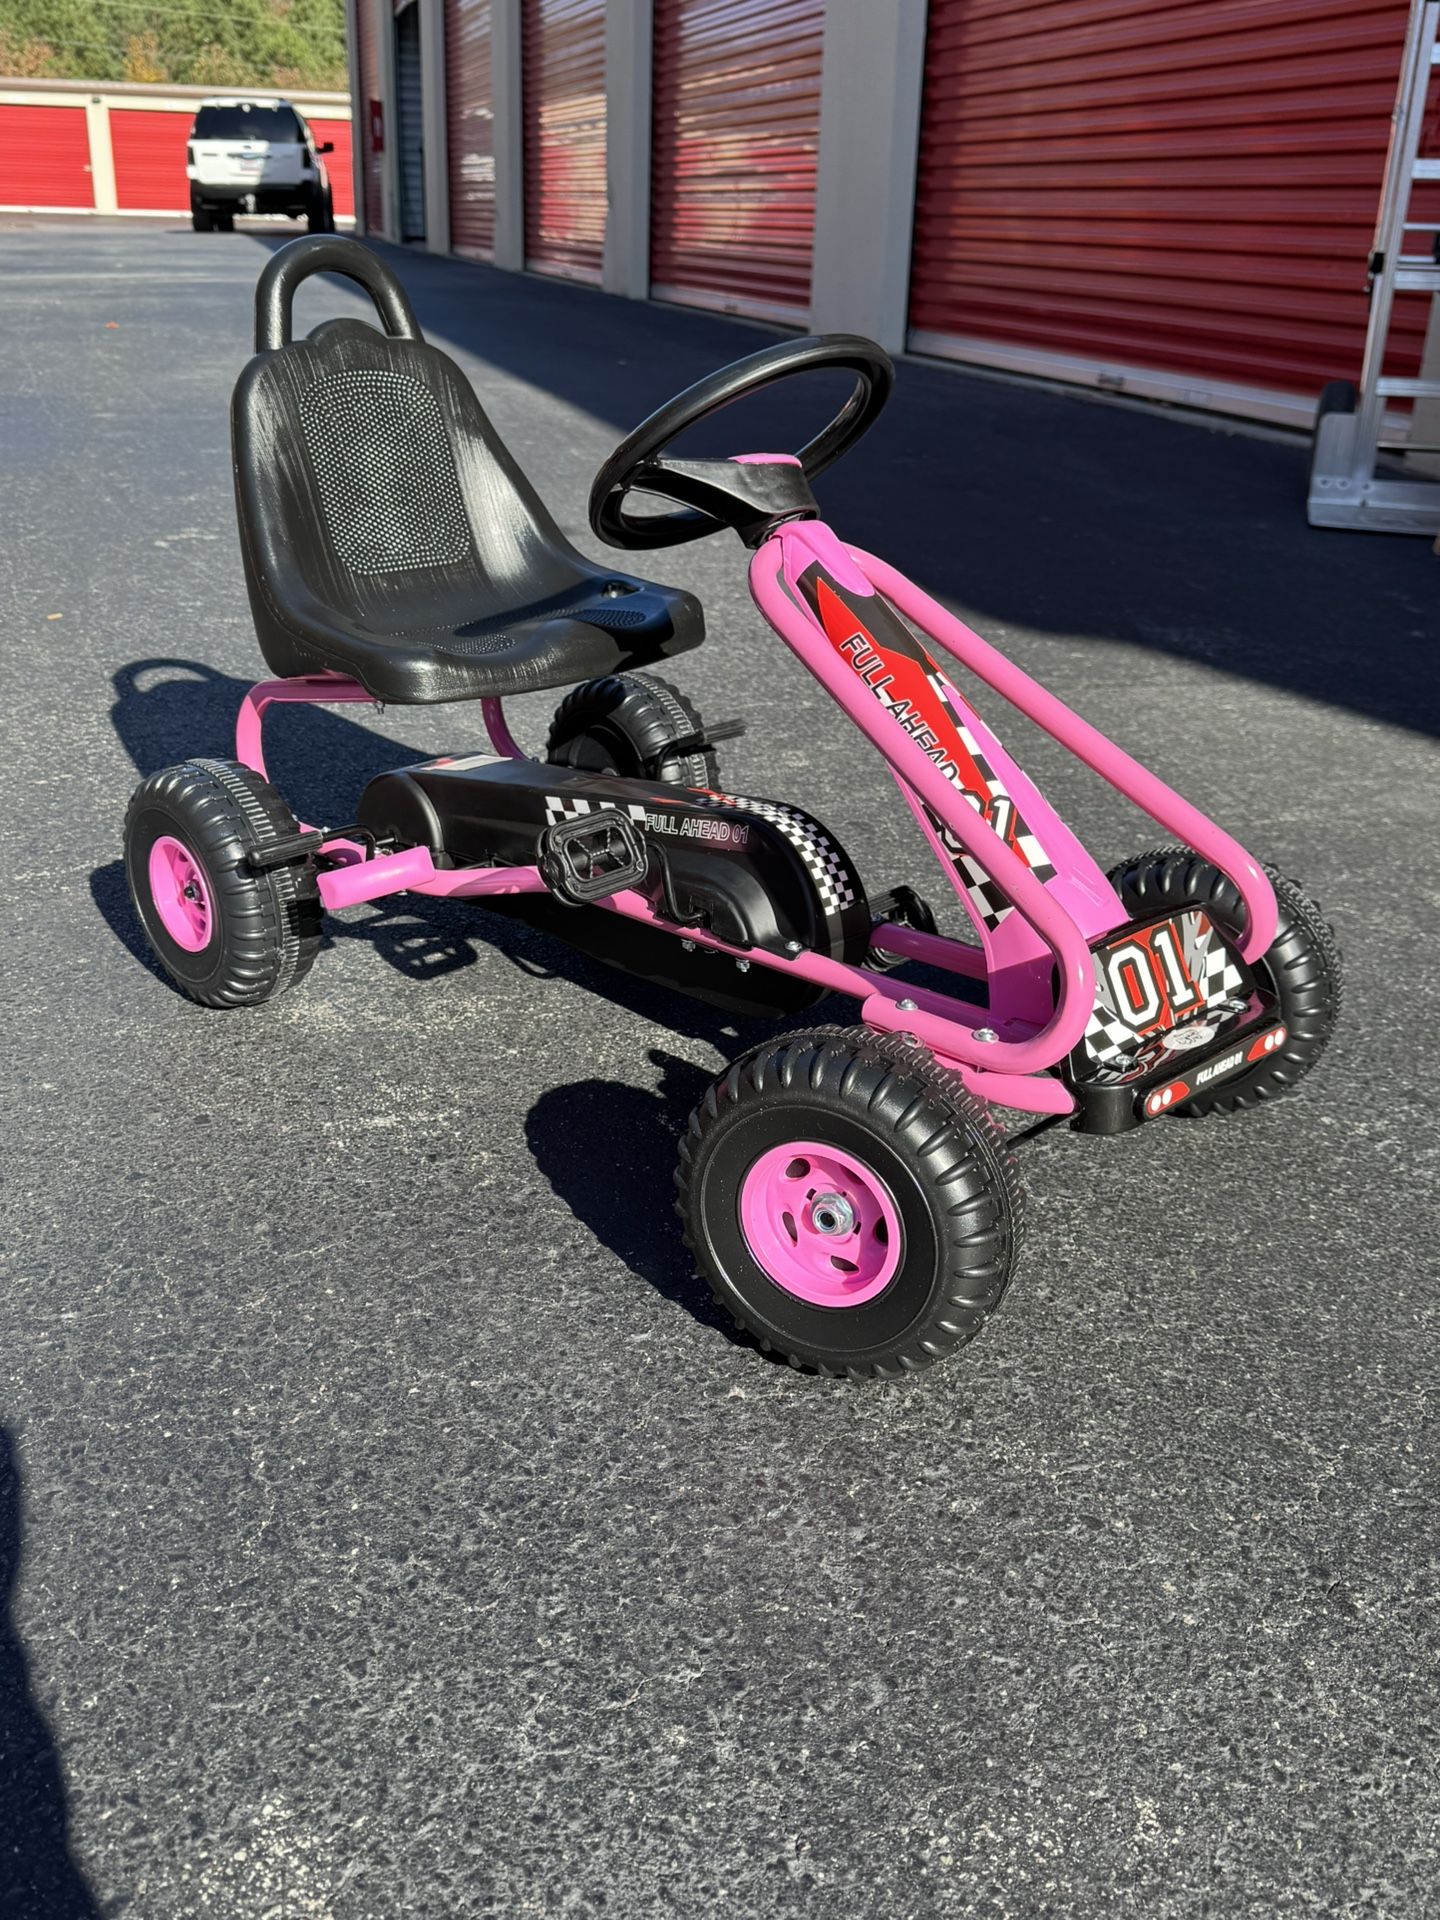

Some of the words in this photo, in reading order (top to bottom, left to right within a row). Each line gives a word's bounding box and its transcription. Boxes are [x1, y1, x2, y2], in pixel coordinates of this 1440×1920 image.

[839, 631, 895, 700] FULL
[645, 813, 678, 835] FULL
[680, 817, 730, 841] AHEAD
[732, 824, 749, 844] 01
[1107, 926, 1196, 1029] 01
